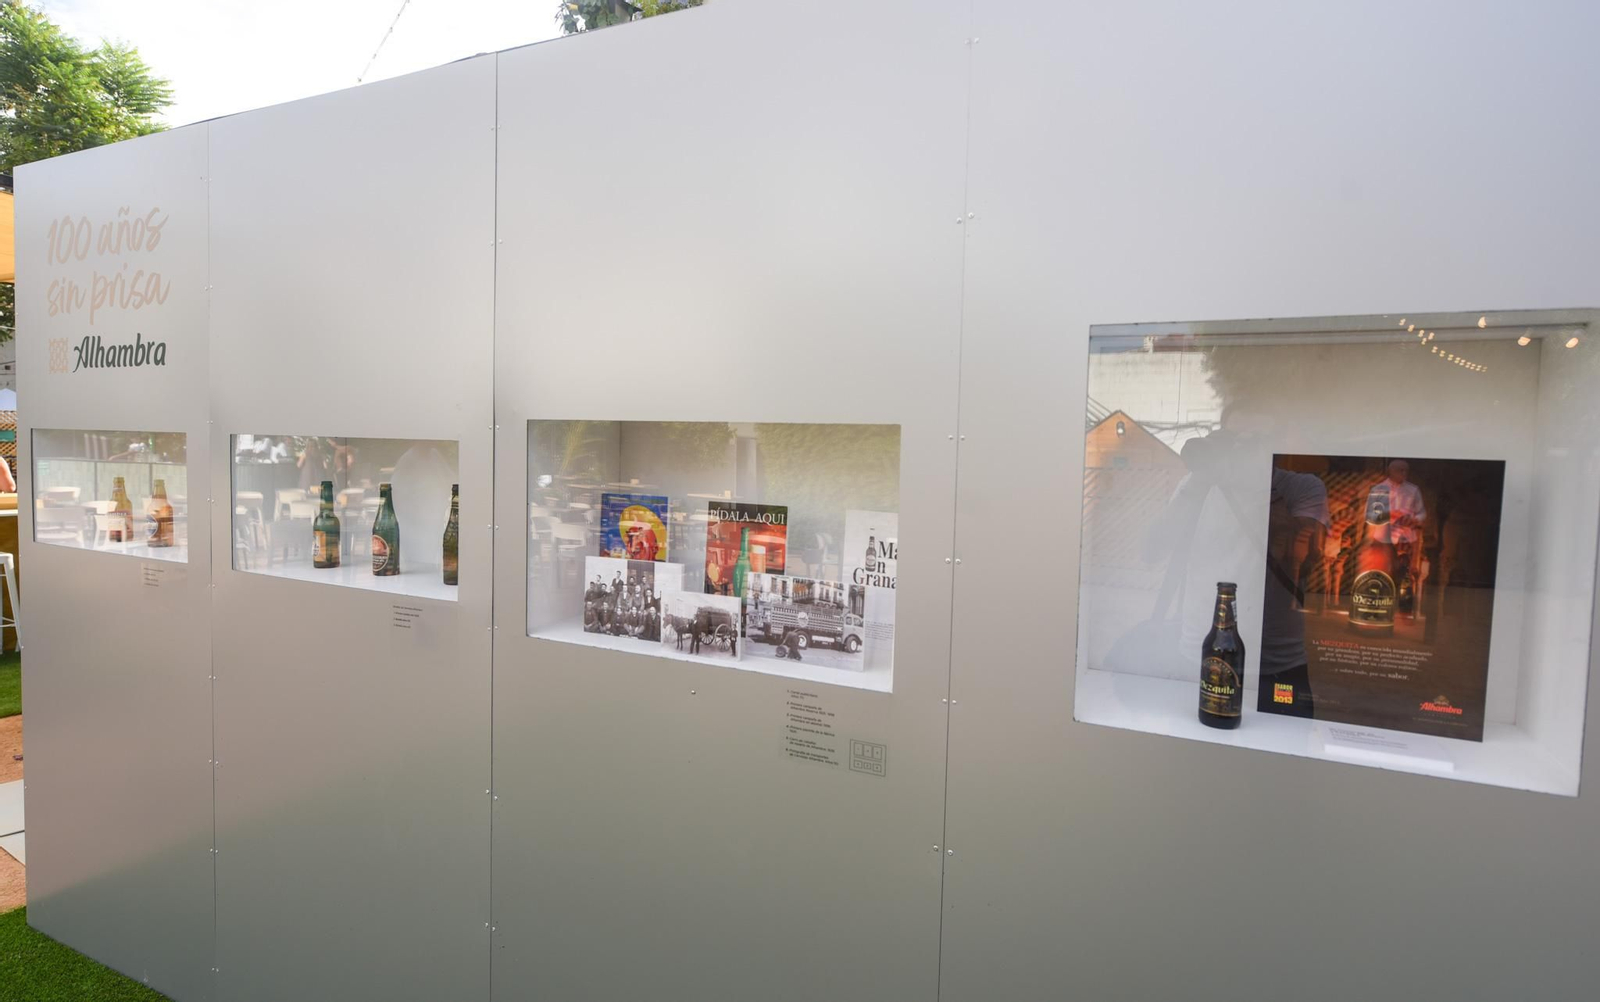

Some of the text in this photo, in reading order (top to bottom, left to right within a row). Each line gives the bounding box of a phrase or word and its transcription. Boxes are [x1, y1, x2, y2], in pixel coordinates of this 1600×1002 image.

[47, 206, 169, 266] 100 años
[47, 262, 171, 325] sin prisa
[73, 333, 166, 372] Alhambra
[710, 507, 784, 526] PÍDALA AQUI
[1353, 594, 1393, 606] Mezquita
[1320, 640, 1359, 649] MEZQUITA
[1274, 695, 1293, 704] 2013
[1420, 702, 1463, 715] Alhambra
